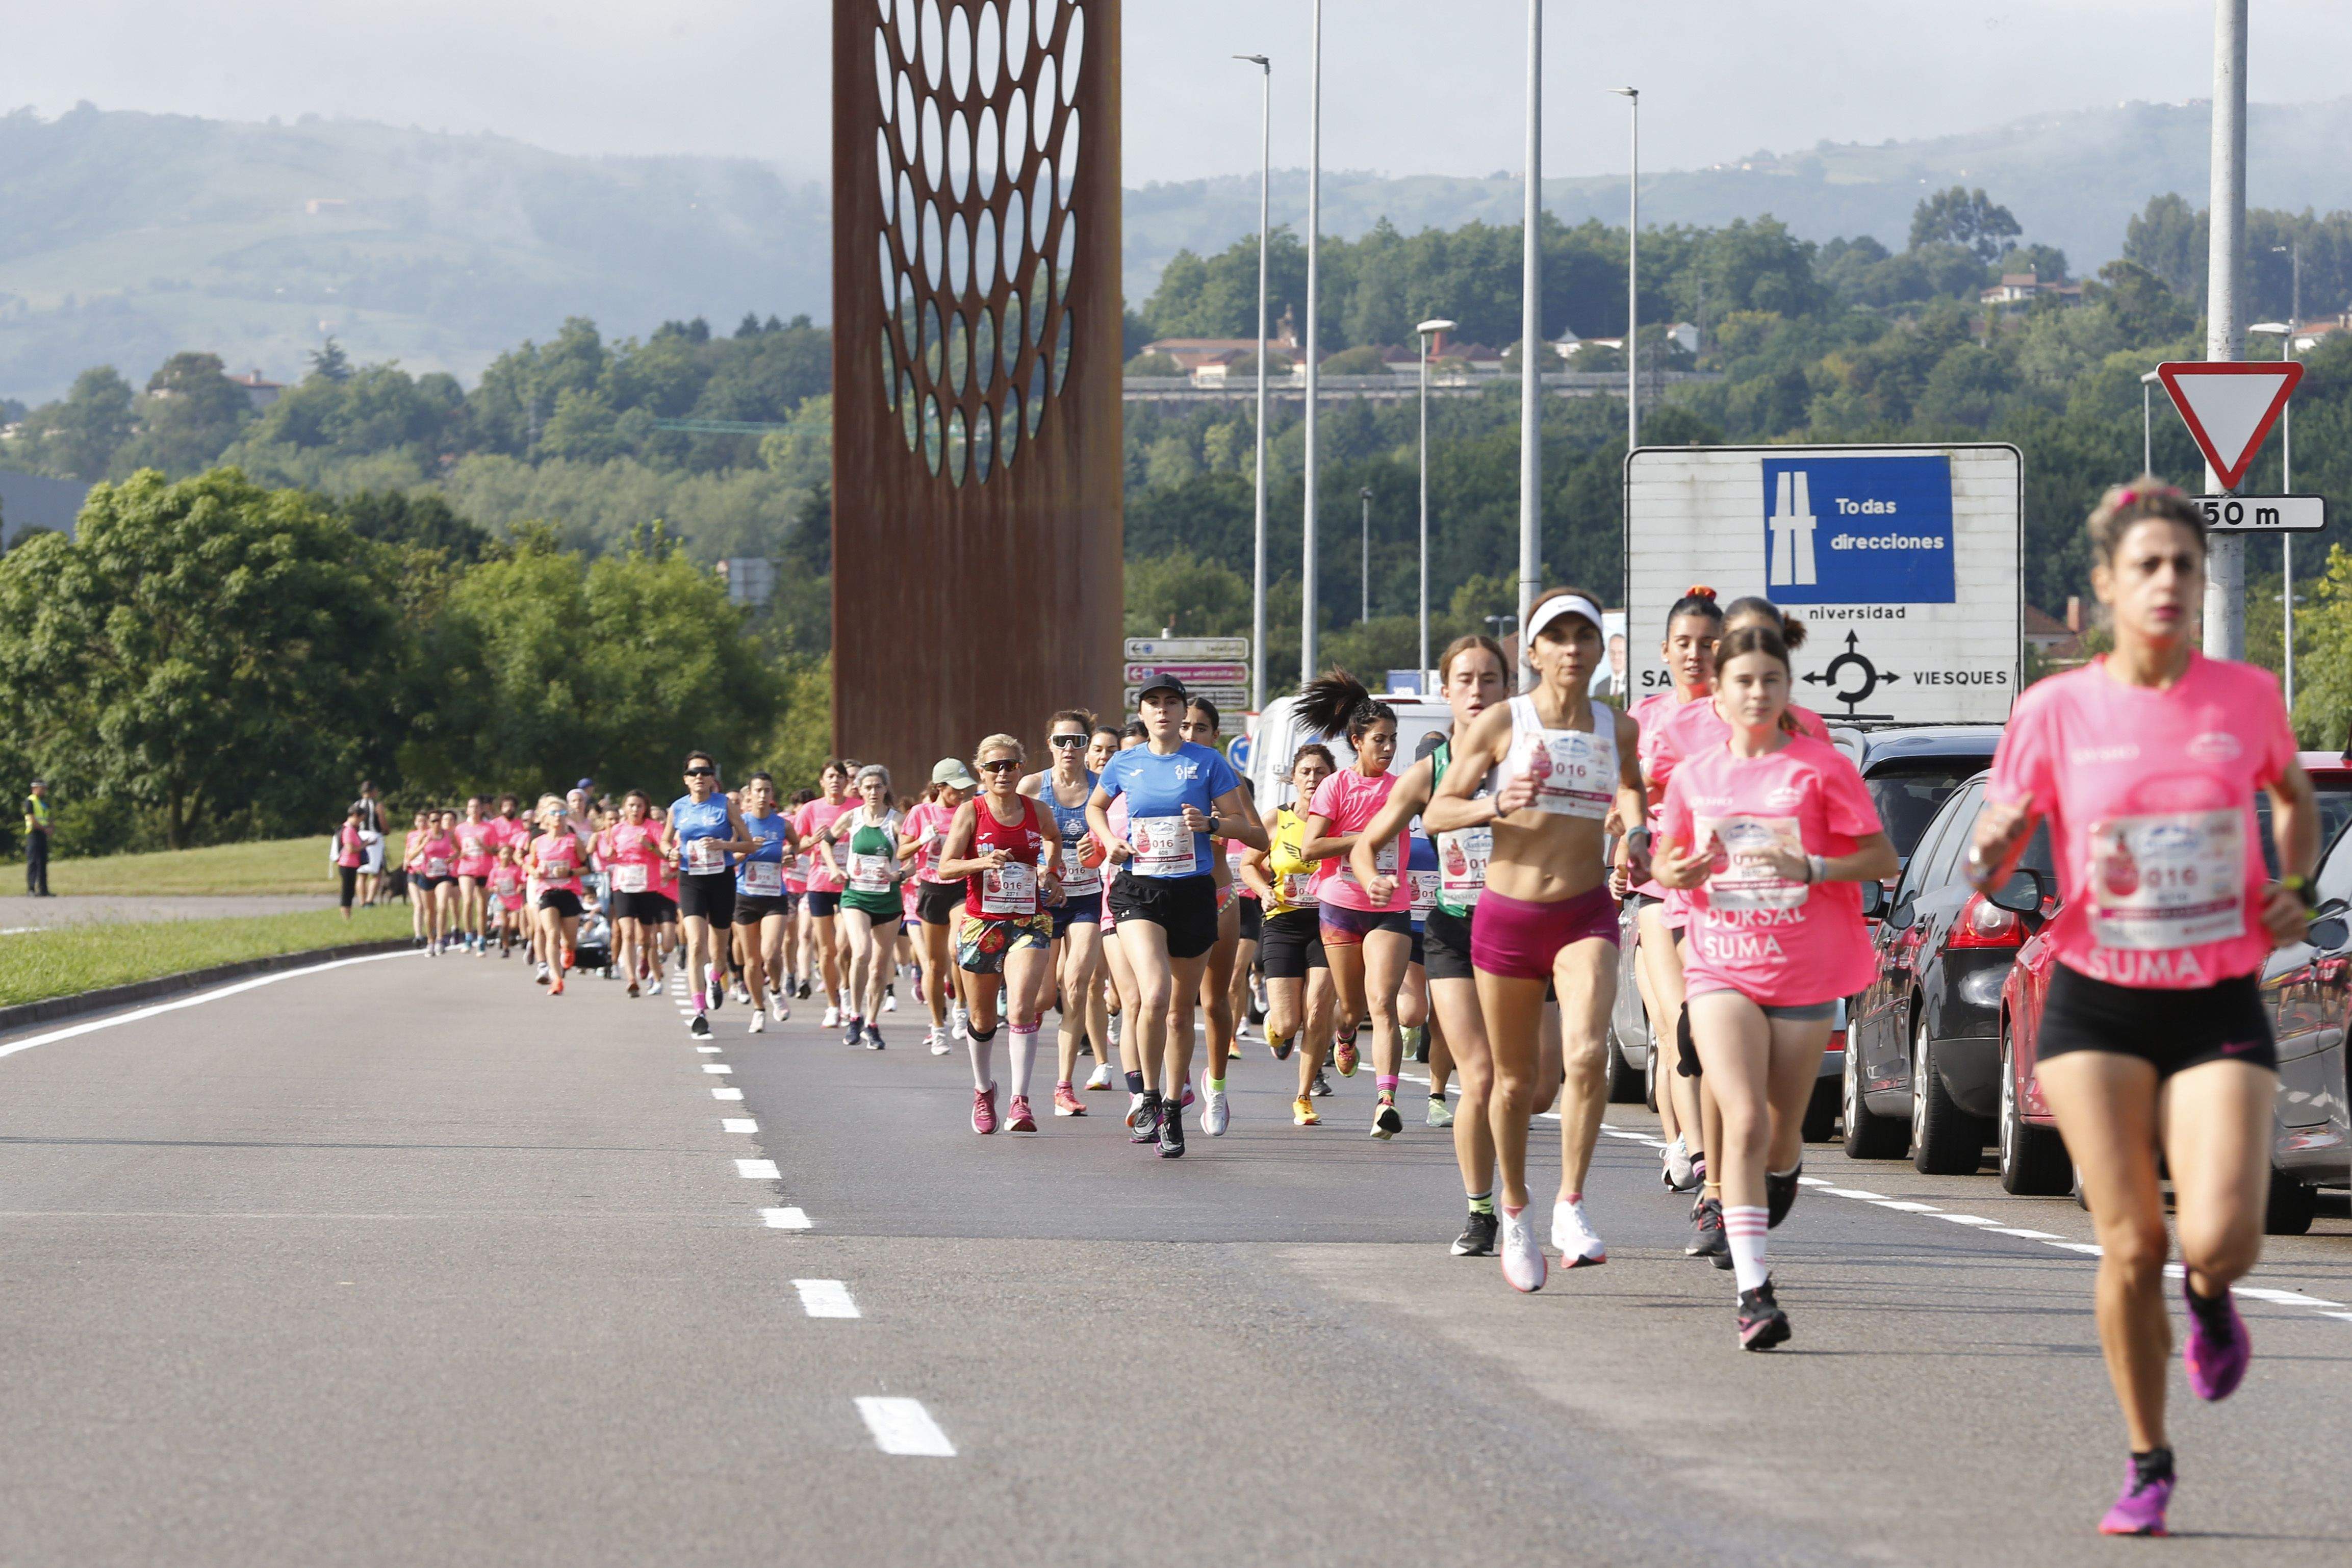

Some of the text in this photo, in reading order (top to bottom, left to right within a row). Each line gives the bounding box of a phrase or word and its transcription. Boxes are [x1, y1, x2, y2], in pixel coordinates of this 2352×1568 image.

[1836, 498, 1897, 515] Todas
[2257, 508, 2279, 524] m
[1830, 533, 1944, 550] direcciones
[1914, 671, 2006, 685] VIESQUES
[1556, 763, 1587, 777] 016
[1153, 839, 1173, 847] 016
[1704, 907, 1806, 929] DORSAL
[1705, 934, 1783, 960] SUMA
[2089, 947, 2205, 983] SUMA
